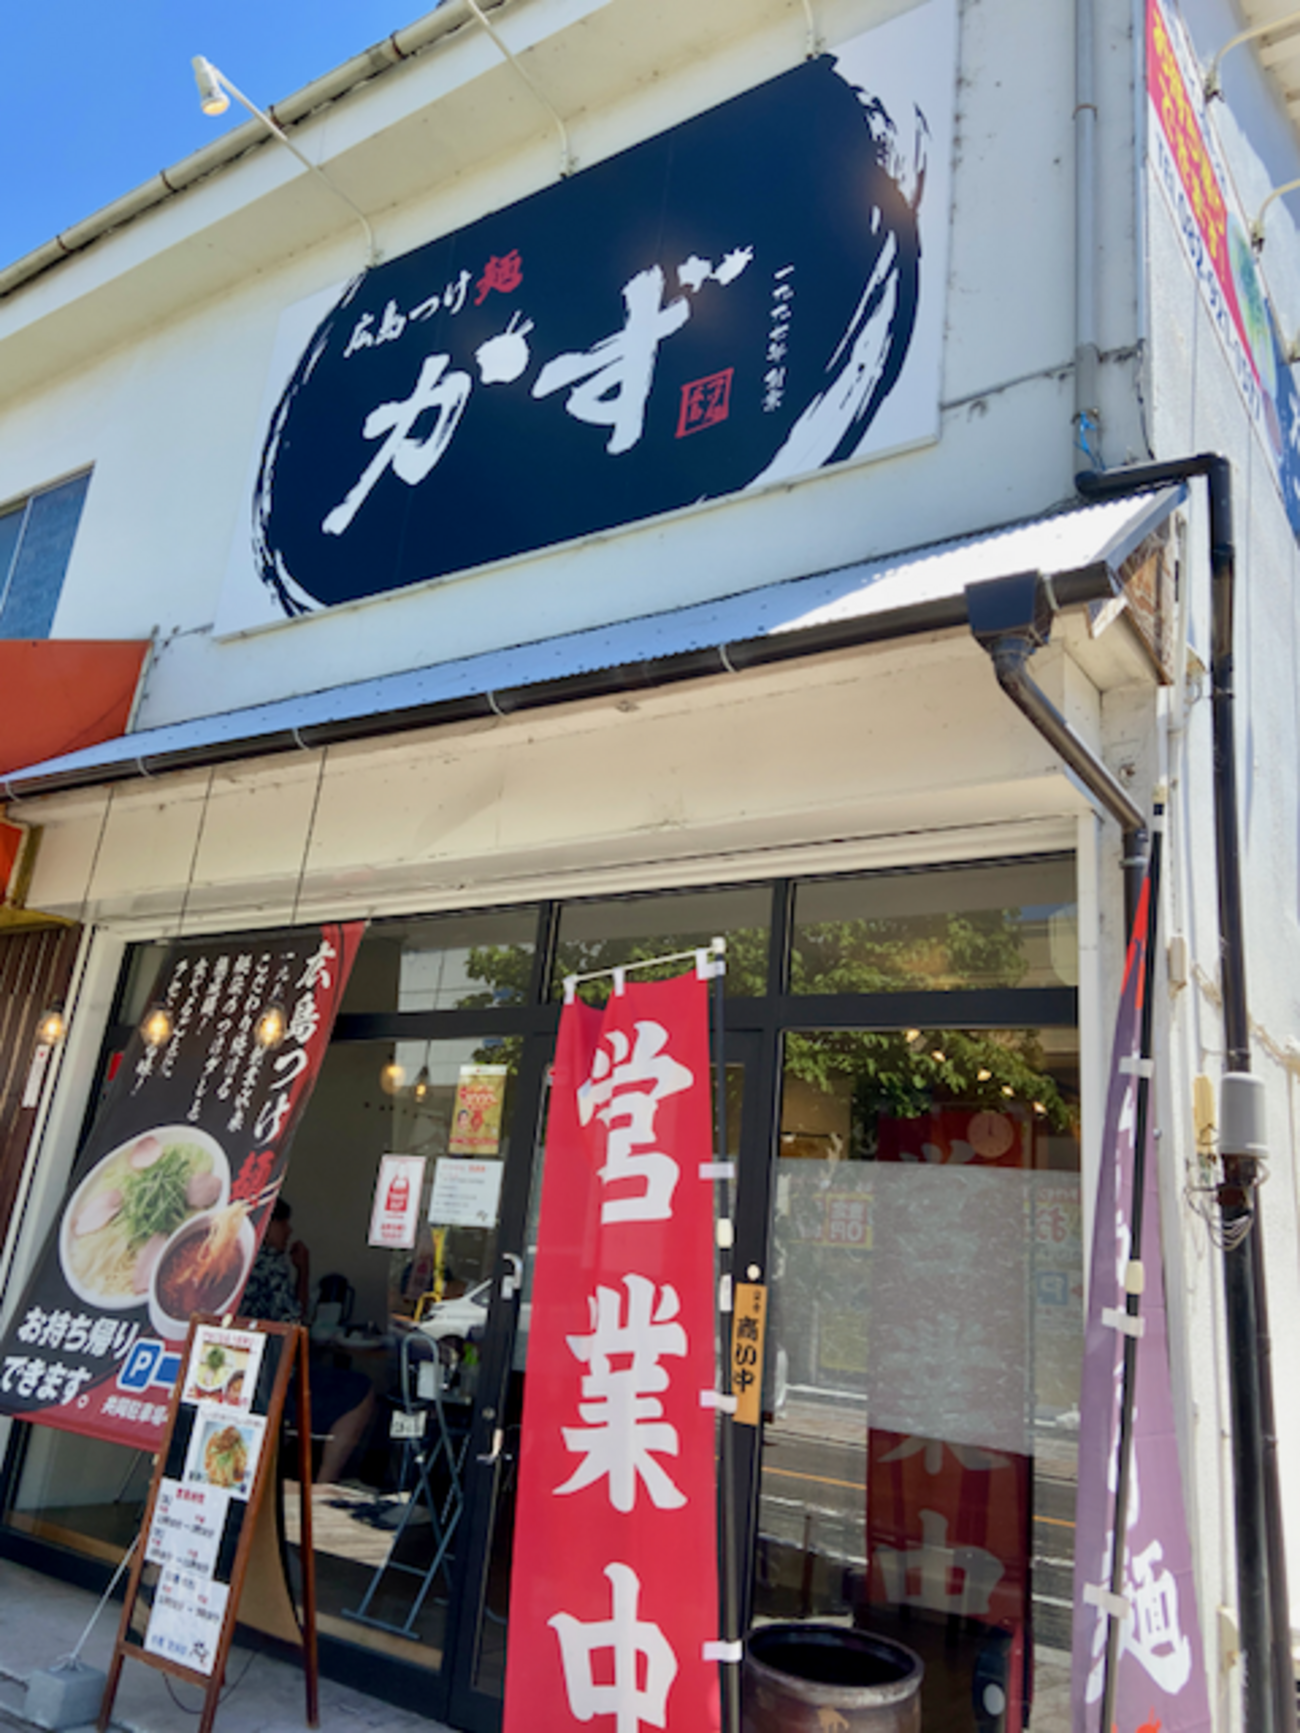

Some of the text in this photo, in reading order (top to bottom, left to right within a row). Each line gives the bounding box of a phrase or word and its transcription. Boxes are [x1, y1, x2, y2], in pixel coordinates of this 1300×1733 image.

[18, 1306, 140, 1360] お持ち帰り
[2, 1356, 93, 1409] できます。
[547, 1019, 694, 1733] 営業中
